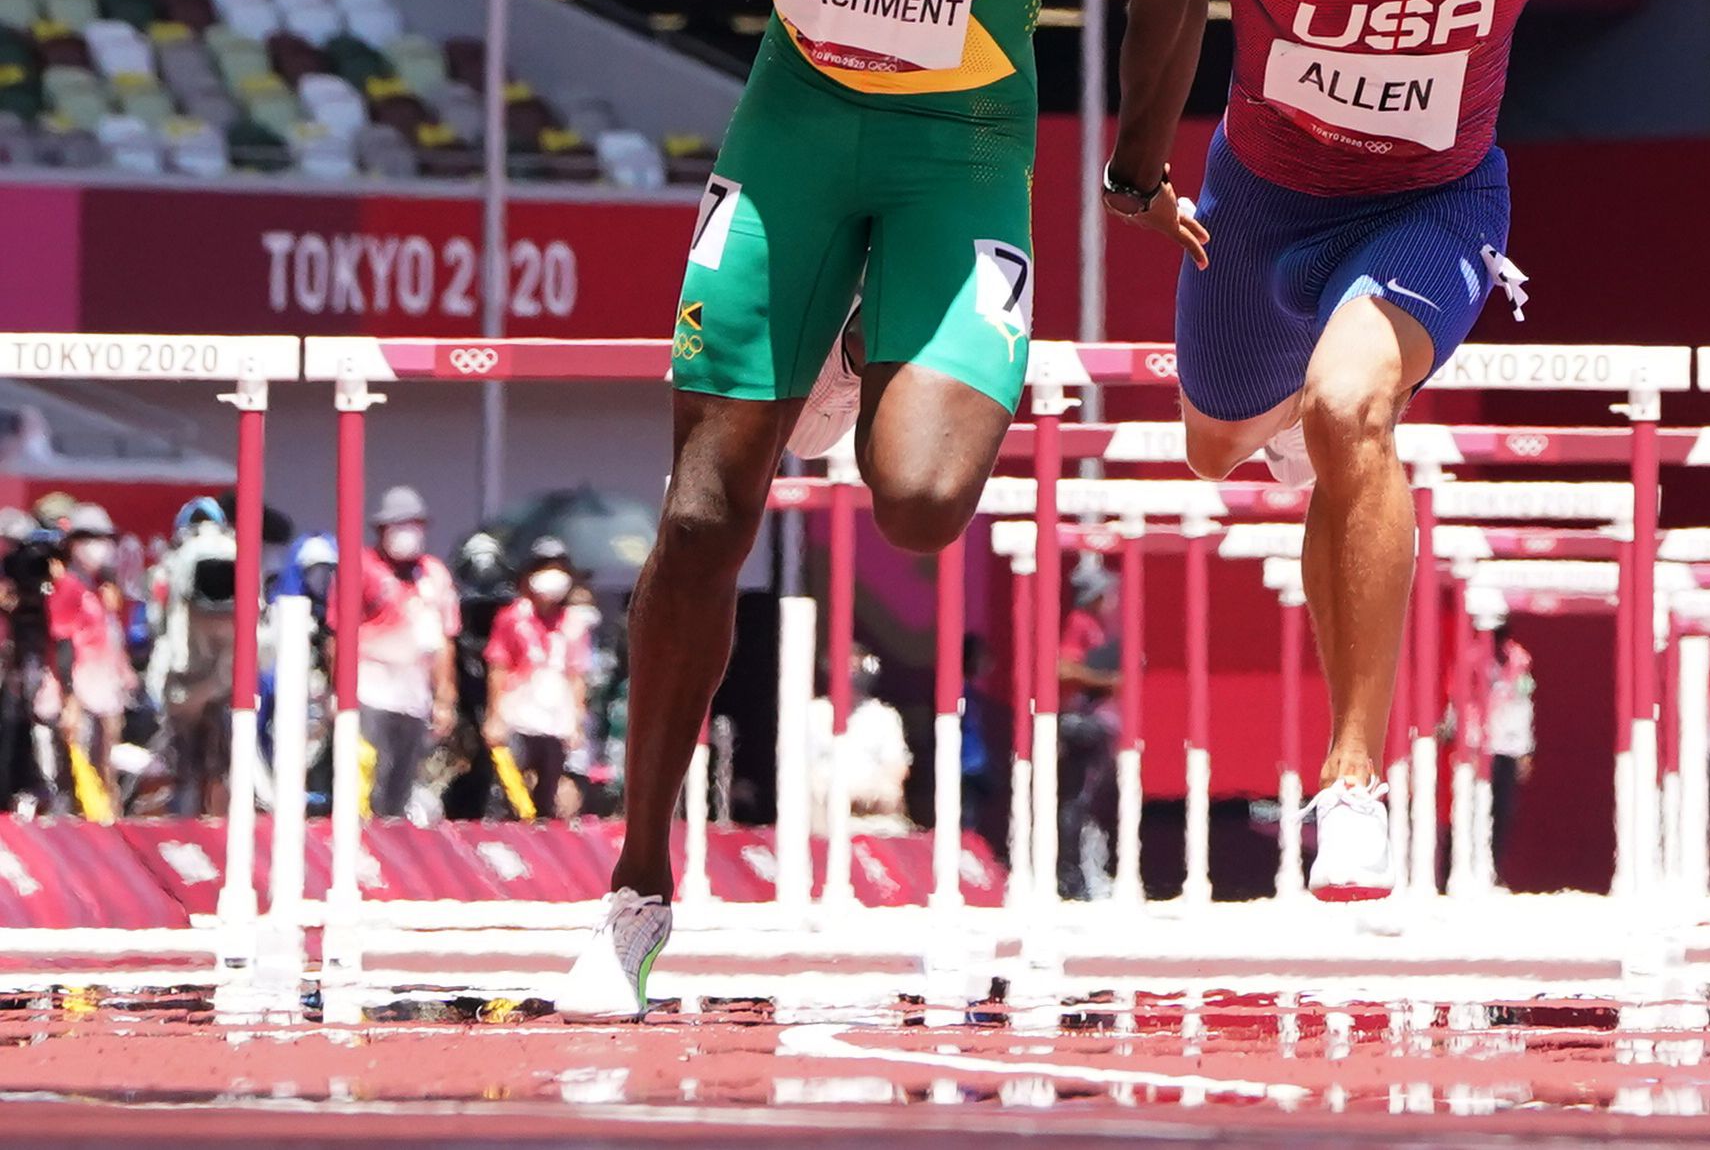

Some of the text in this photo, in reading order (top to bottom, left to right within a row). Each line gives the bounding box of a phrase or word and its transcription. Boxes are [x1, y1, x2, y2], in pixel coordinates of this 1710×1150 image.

[1298, 61, 1434, 112] ALLEN
[691, 182, 728, 251] 7
[261, 230, 579, 318] TOKYO 220
[994, 247, 1028, 313] 7
[12, 341, 219, 372] TOKYO 2020
[1432, 353, 1611, 382] KYO 2020
